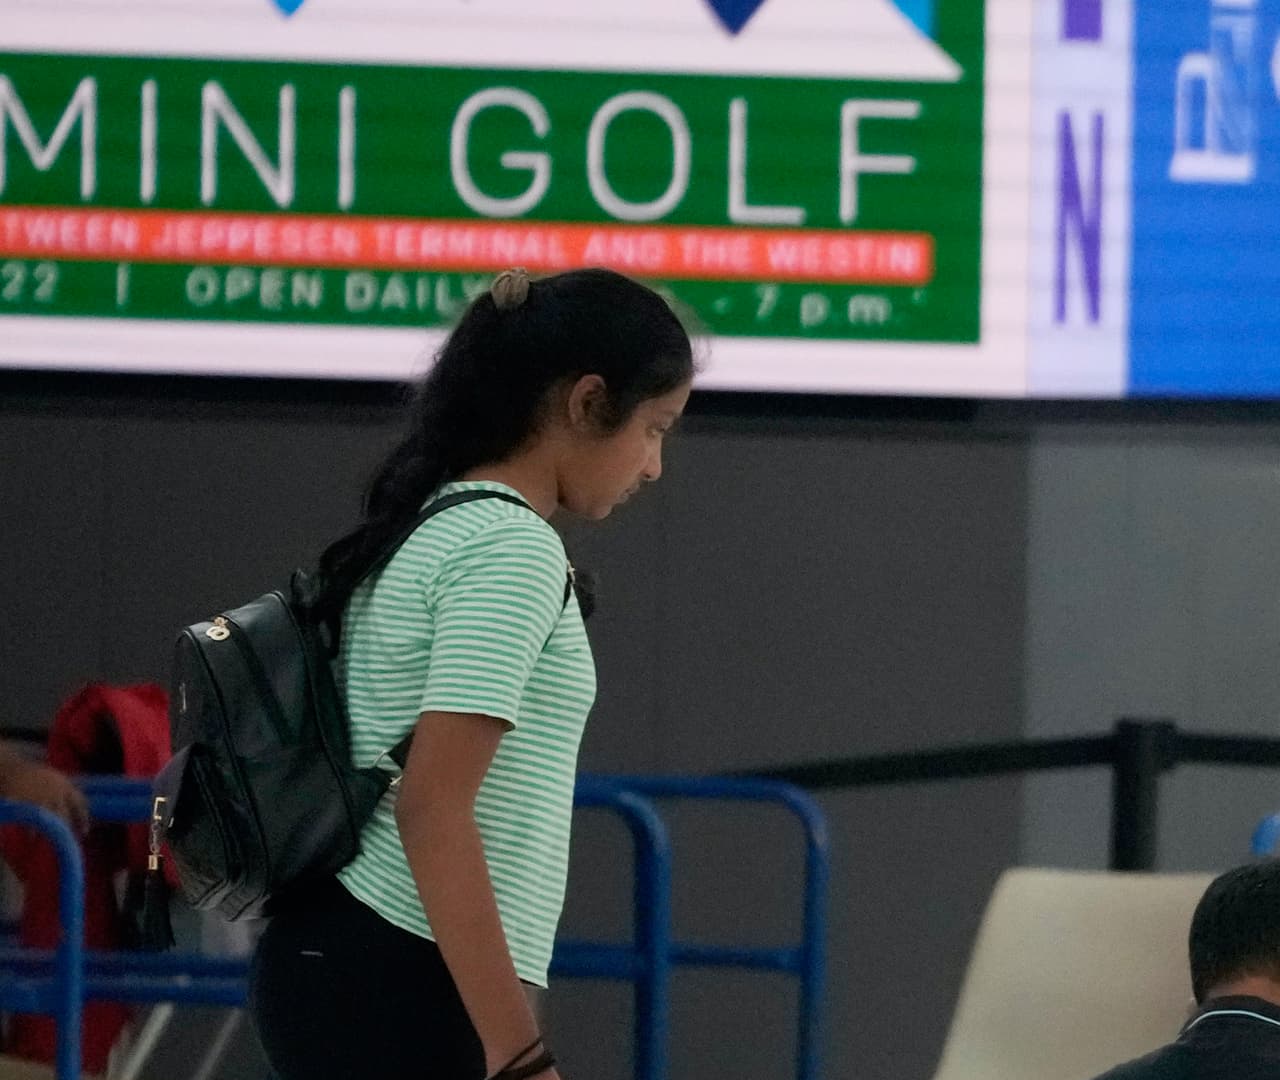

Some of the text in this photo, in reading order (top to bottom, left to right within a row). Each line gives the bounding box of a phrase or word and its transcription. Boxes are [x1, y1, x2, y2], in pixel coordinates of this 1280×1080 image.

[0, 74, 922, 224] MINI GOLF
[376, 221, 564, 267] TERMINAL
[583, 229, 667, 270] AND
[681, 232, 750, 272] THE
[767, 235, 921, 277] WESTIN
[185, 265, 324, 311] OPEN
